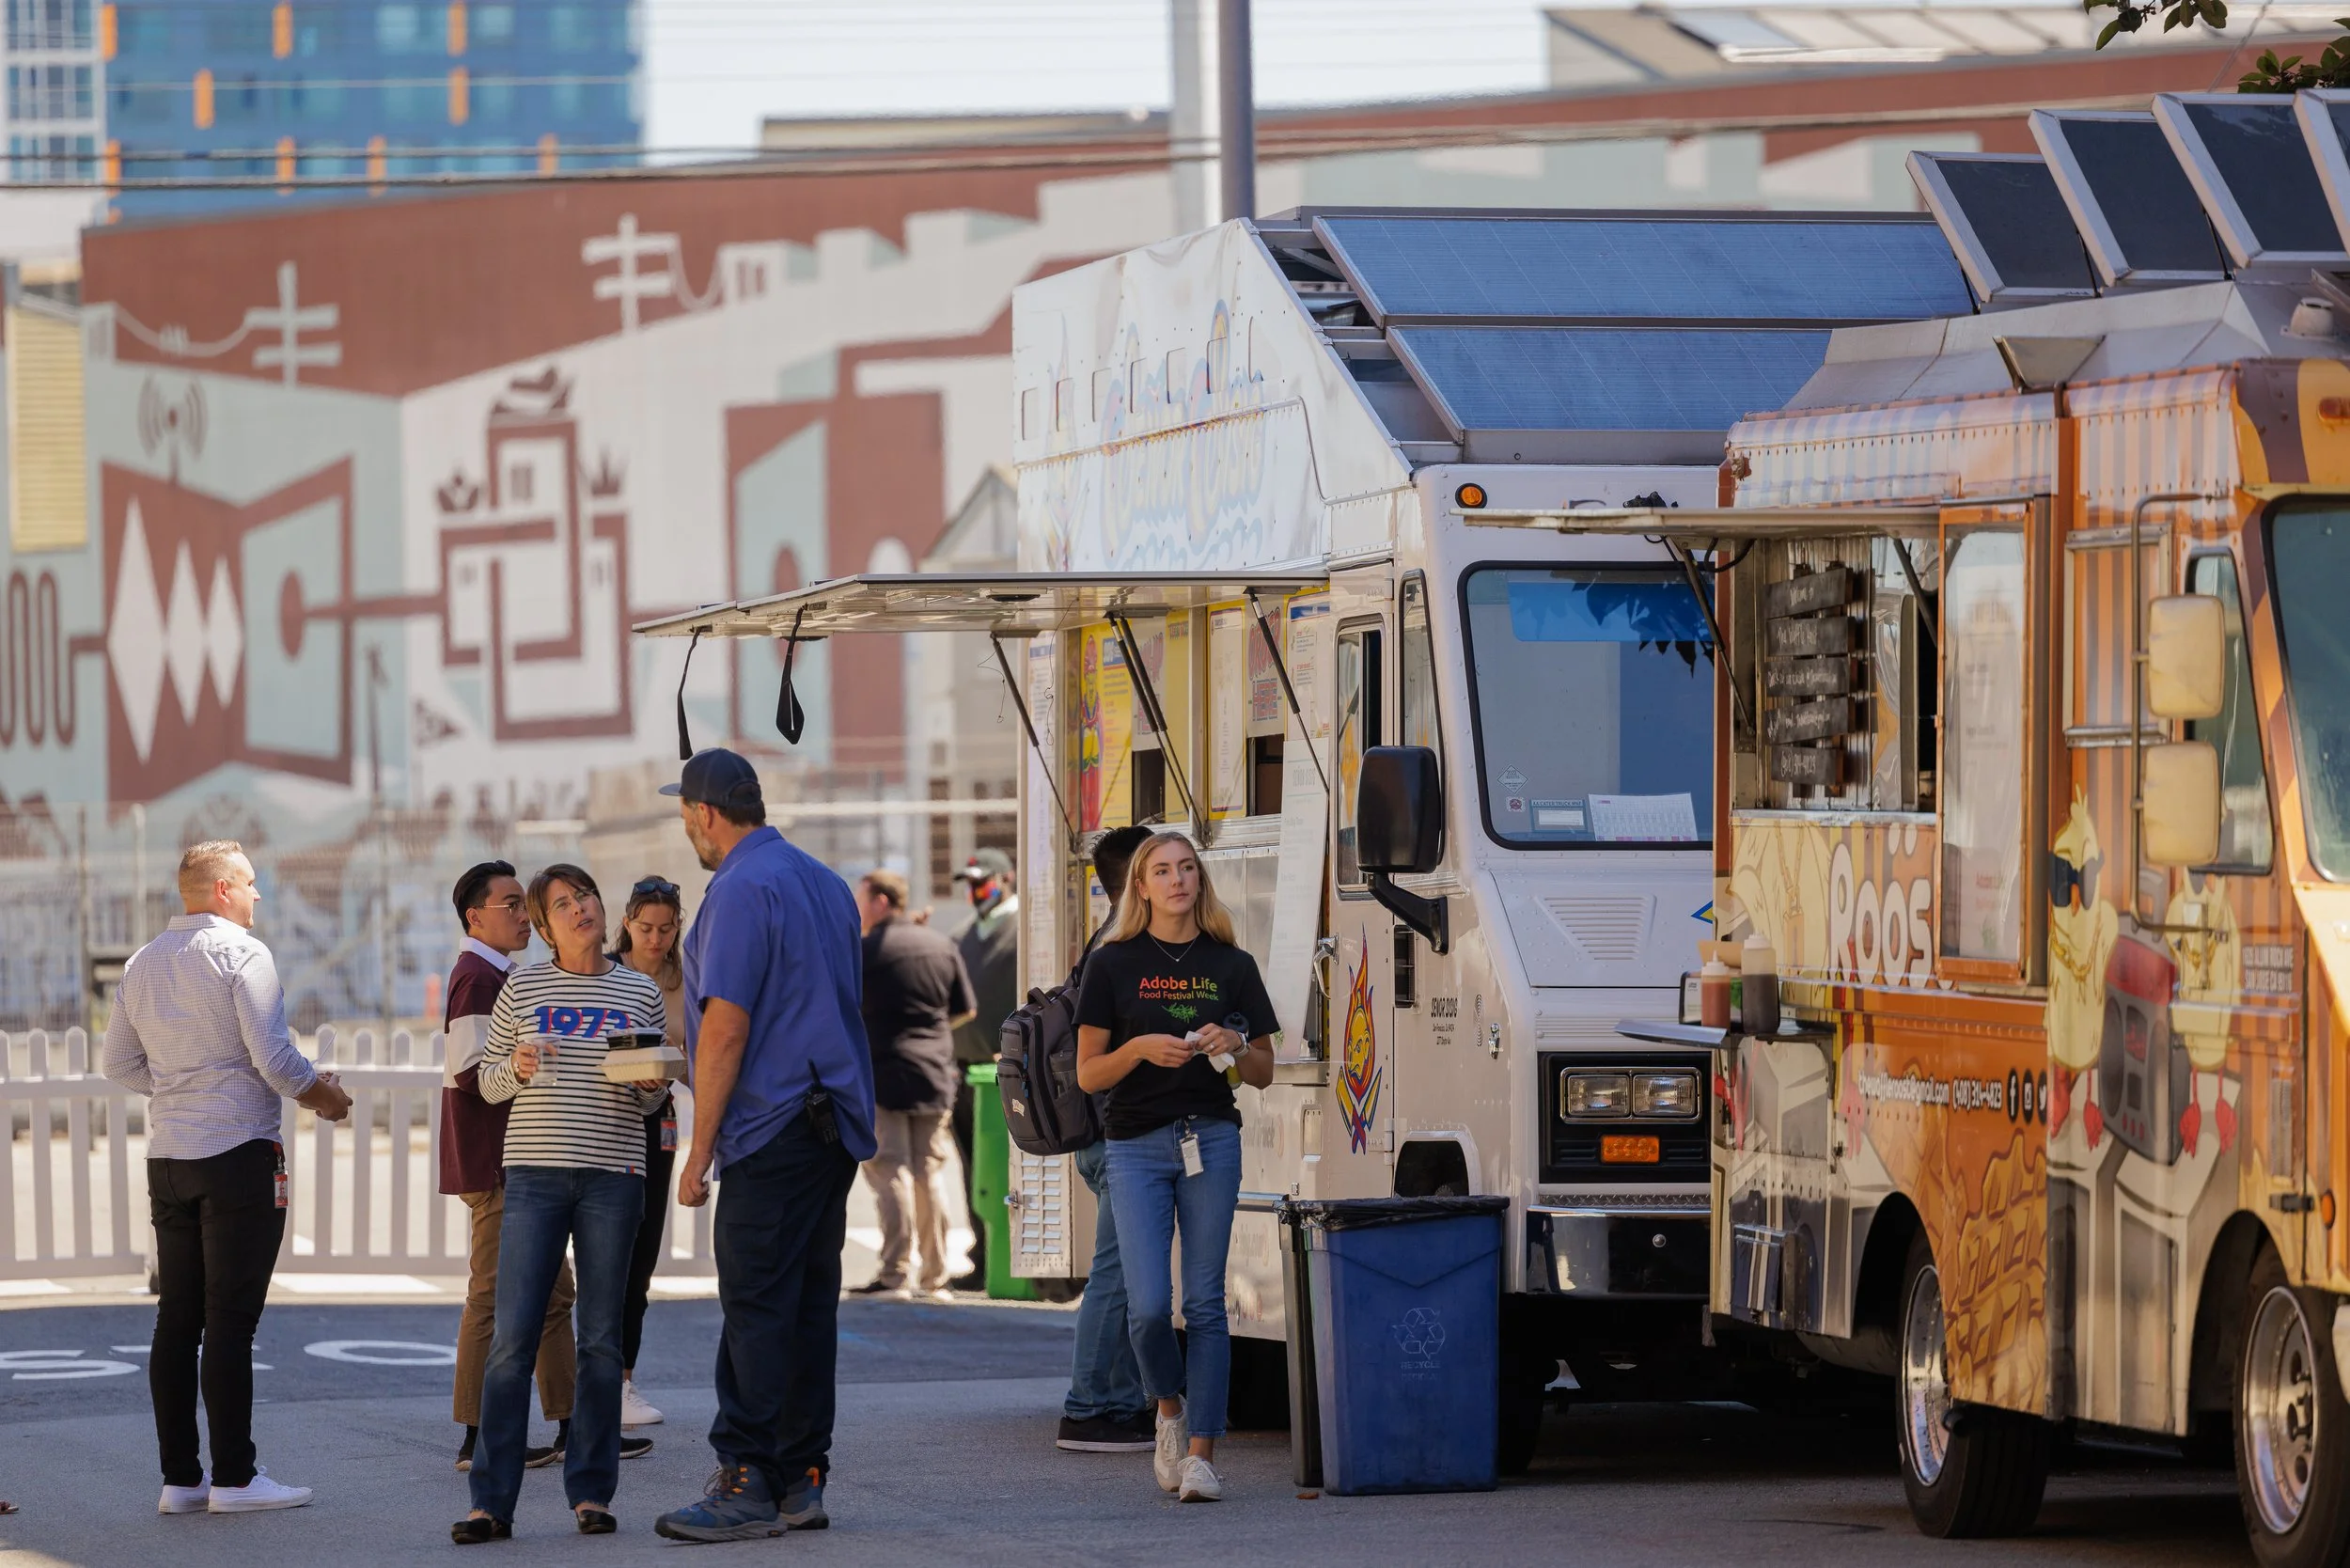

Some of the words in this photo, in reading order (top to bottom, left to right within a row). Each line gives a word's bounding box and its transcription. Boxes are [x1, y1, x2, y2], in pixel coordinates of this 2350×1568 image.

[1139, 976, 1188, 990] Adobe
[1192, 977, 1217, 992] Life
[1139, 991, 1161, 999] Food
[1163, 991, 1194, 1000] Festival
[1196, 990, 1219, 1001] Week
[1952, 1076, 1970, 1110] (408)
[1402, 1360, 1441, 1369] RECYCLE
